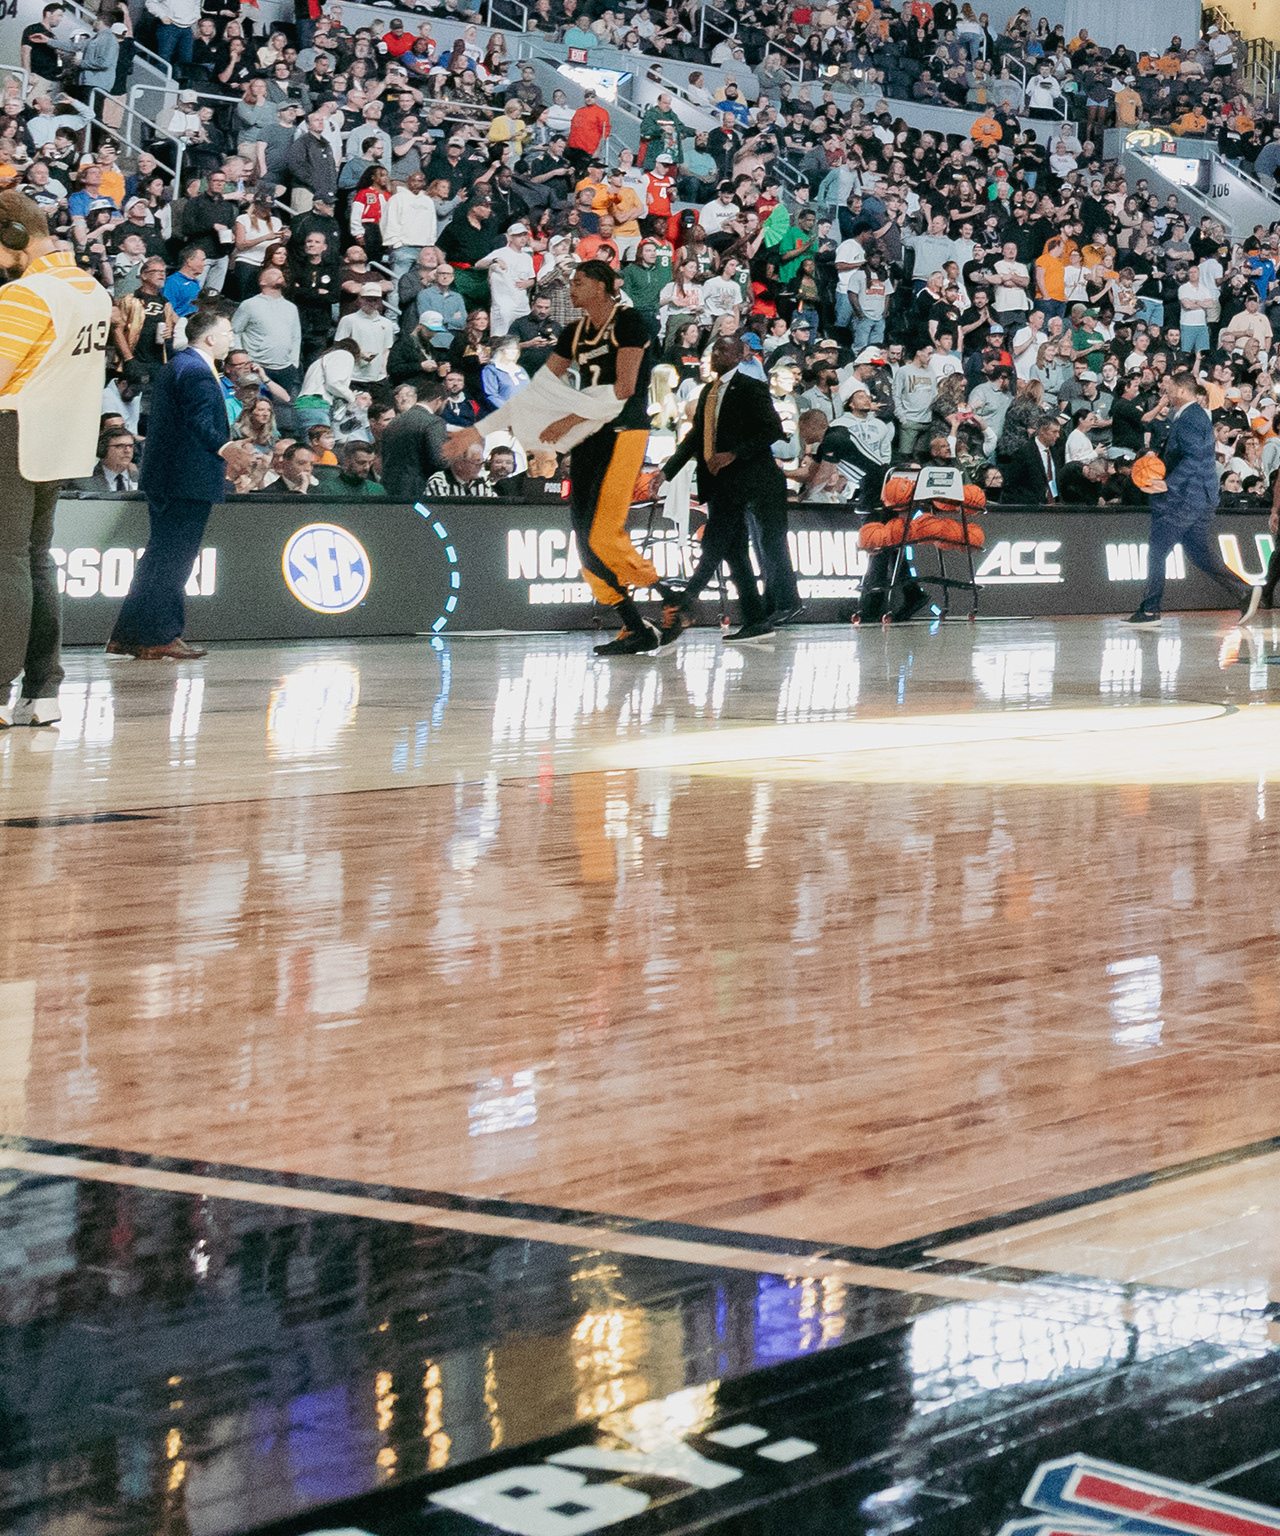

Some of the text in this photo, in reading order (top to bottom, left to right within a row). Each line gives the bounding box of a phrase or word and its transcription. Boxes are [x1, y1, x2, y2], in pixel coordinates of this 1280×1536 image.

[571, 49, 586, 61] EXIT
[659, 183, 668, 199] 4
[1212, 183, 1230, 198] 106
[660, 255, 669, 267] 8
[739, 273, 747, 284] 8
[976, 541, 1062, 576] ACC
[1218, 534, 1276, 586] U
[287, 529, 367, 607] SEC
[427, 1381, 819, 1536] BY:
